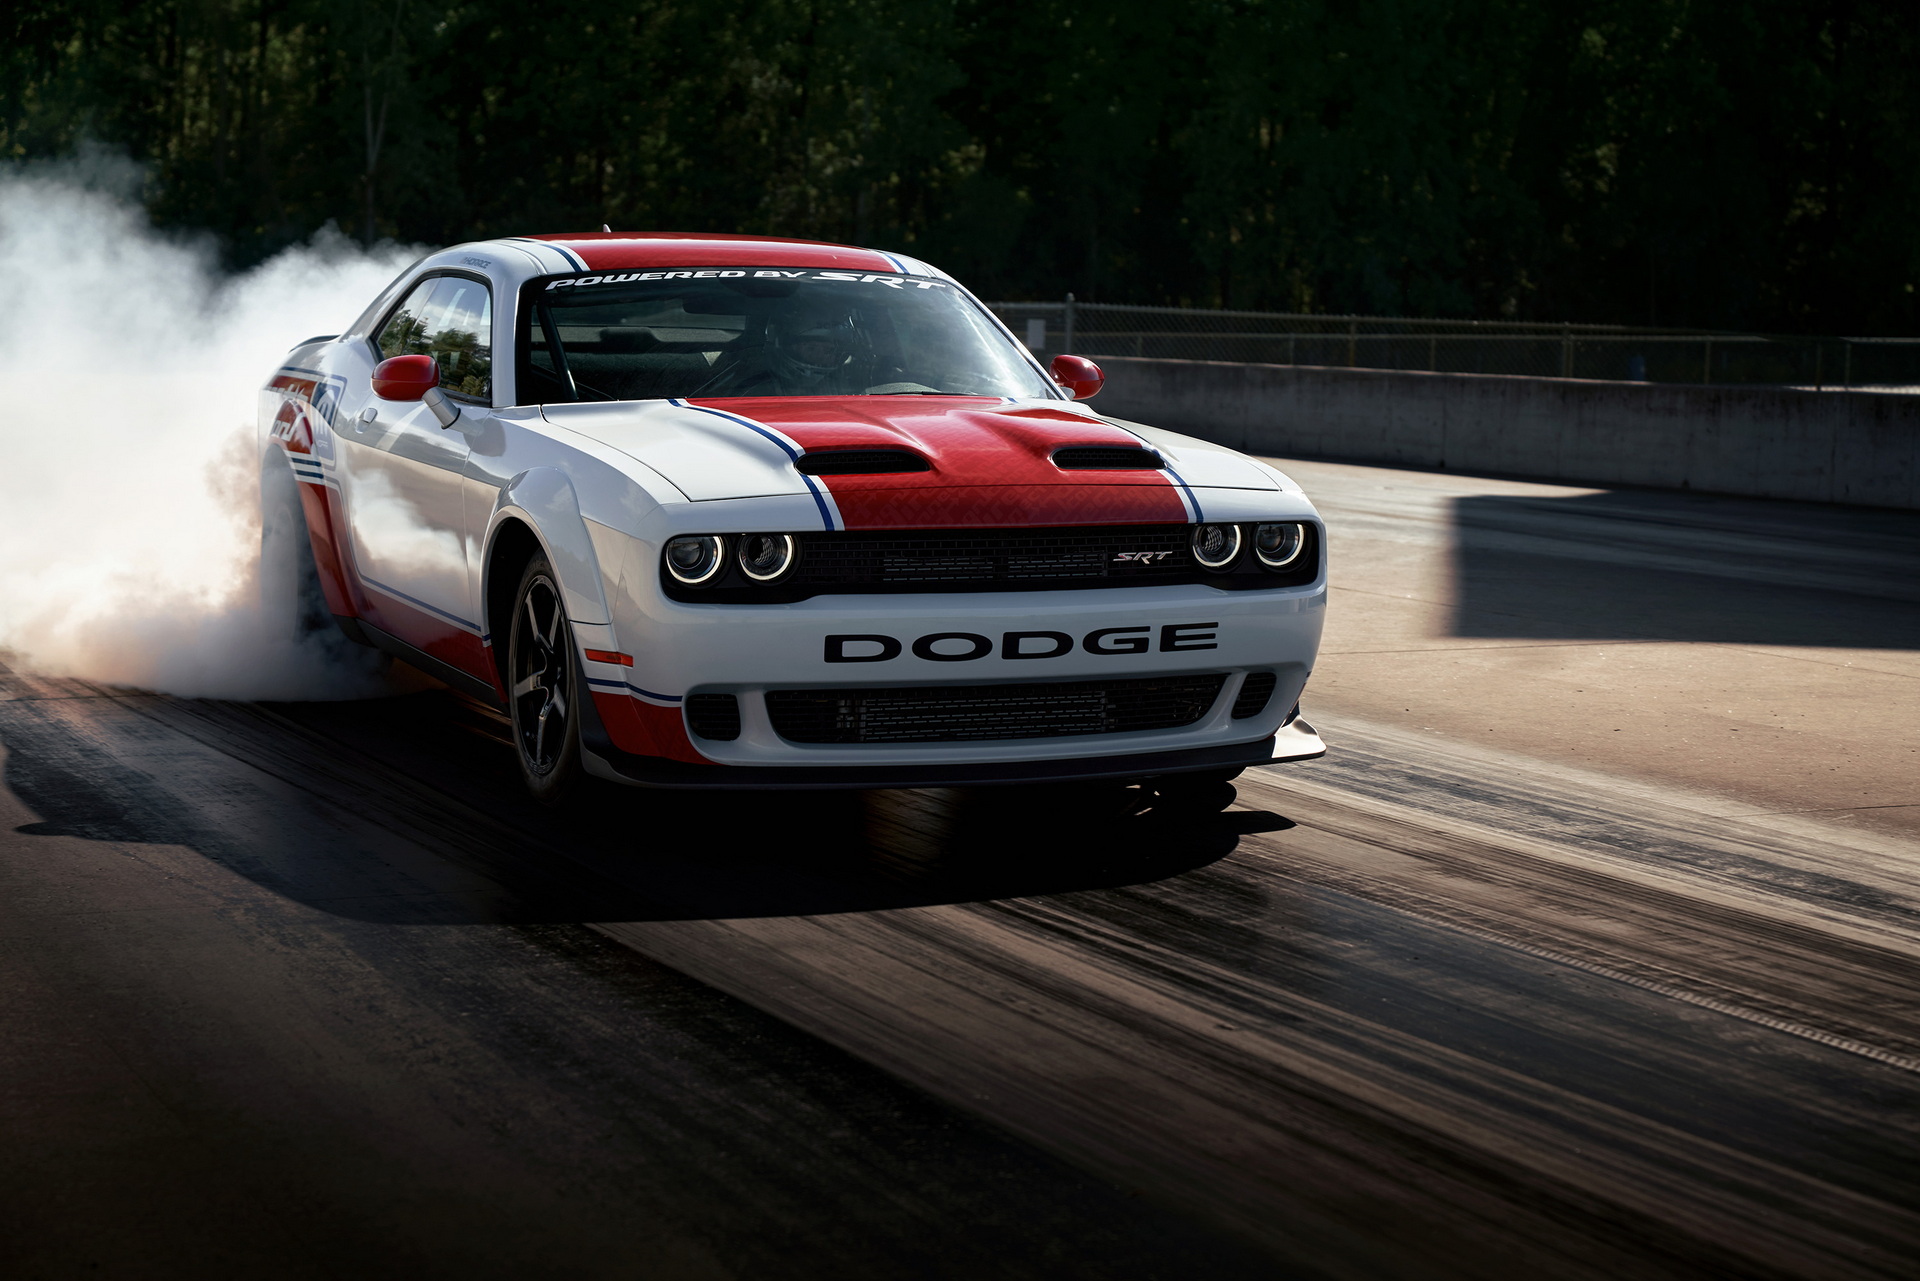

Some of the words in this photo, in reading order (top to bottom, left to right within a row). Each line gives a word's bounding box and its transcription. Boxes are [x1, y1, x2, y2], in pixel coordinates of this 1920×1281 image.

[545, 270, 747, 291] POWERED
[753, 270, 807, 278] BY
[812, 271, 946, 290] SRT
[1112, 550, 1173, 565] SRT
[823, 622, 1220, 663] DODGE
